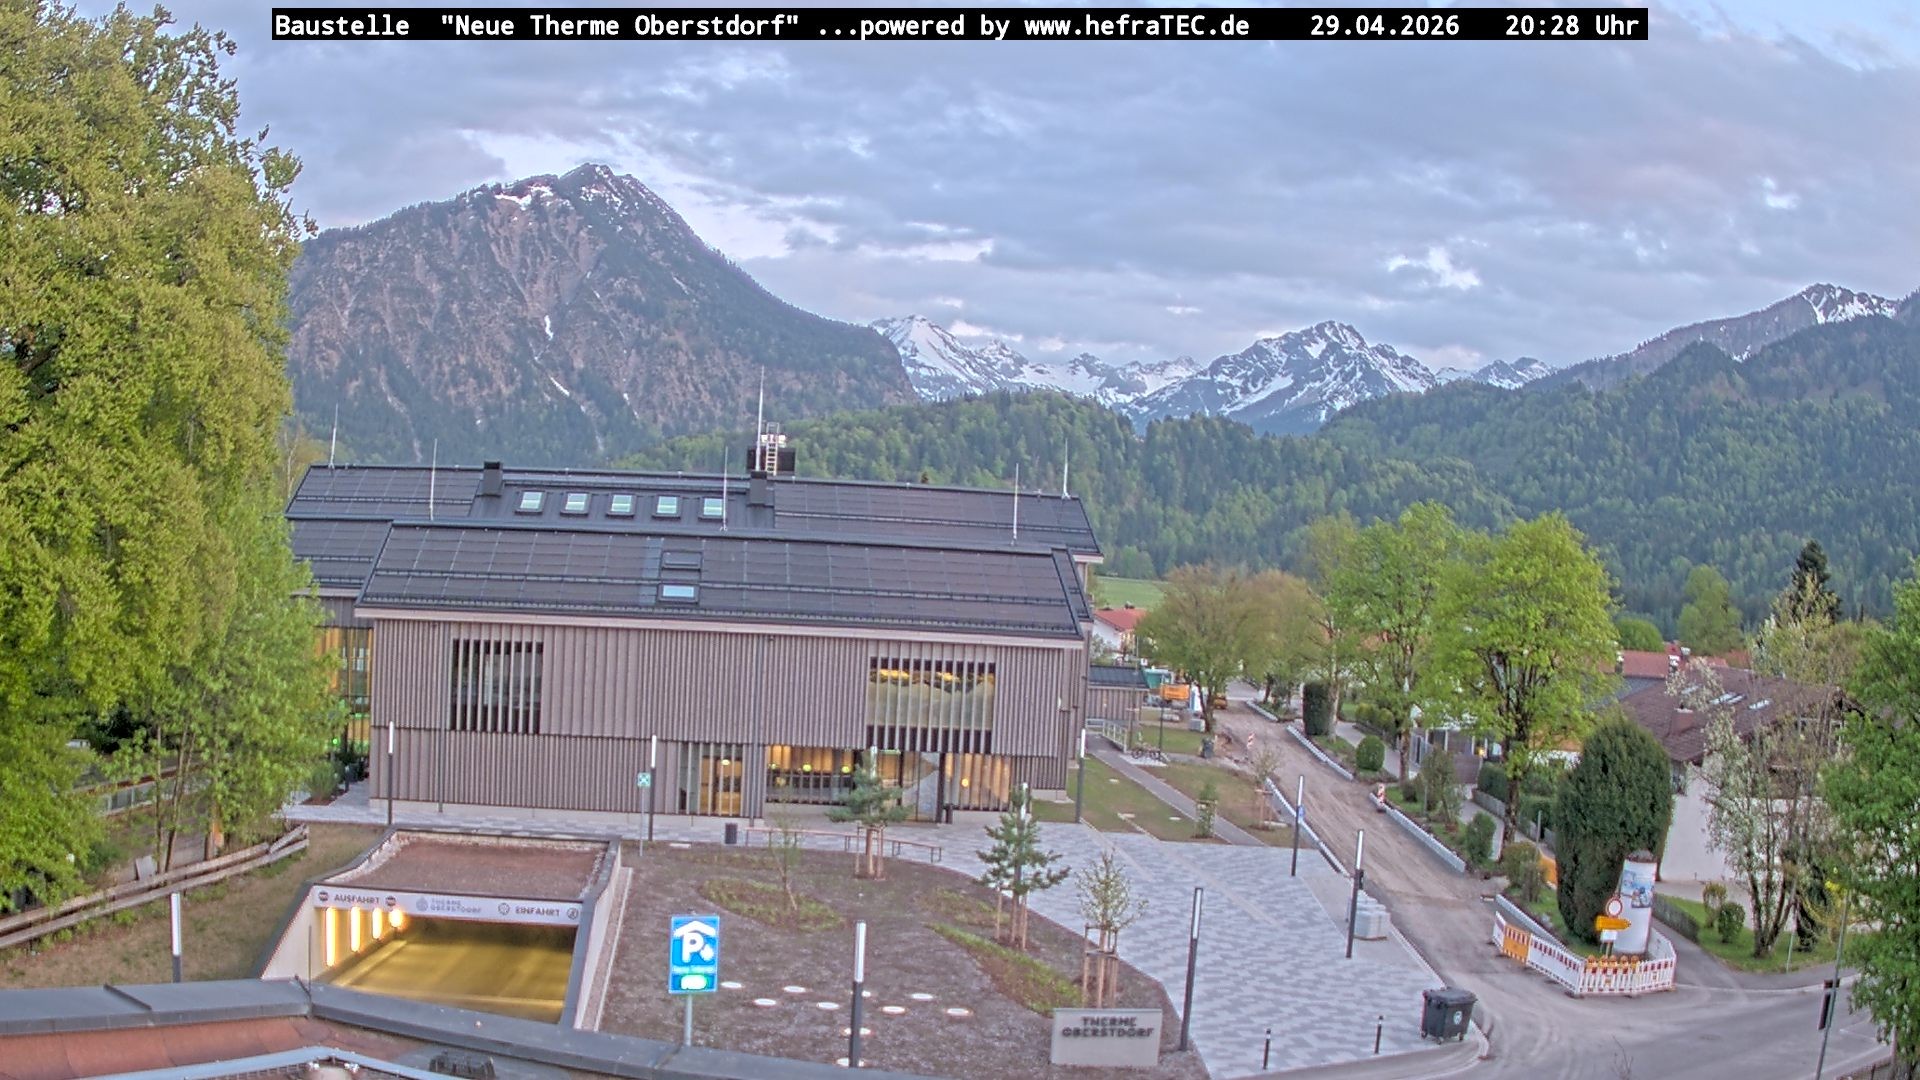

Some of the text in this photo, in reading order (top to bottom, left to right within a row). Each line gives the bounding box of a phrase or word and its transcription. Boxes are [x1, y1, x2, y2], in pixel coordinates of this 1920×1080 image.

[334, 893, 380, 904] AUSFAHRT
[515, 905, 560, 917] EINFAHRT
[682, 931, 704, 963] P
[1082, 1016, 1137, 1027] THERME
[1062, 1027, 1154, 1037] OBERSTDORF
